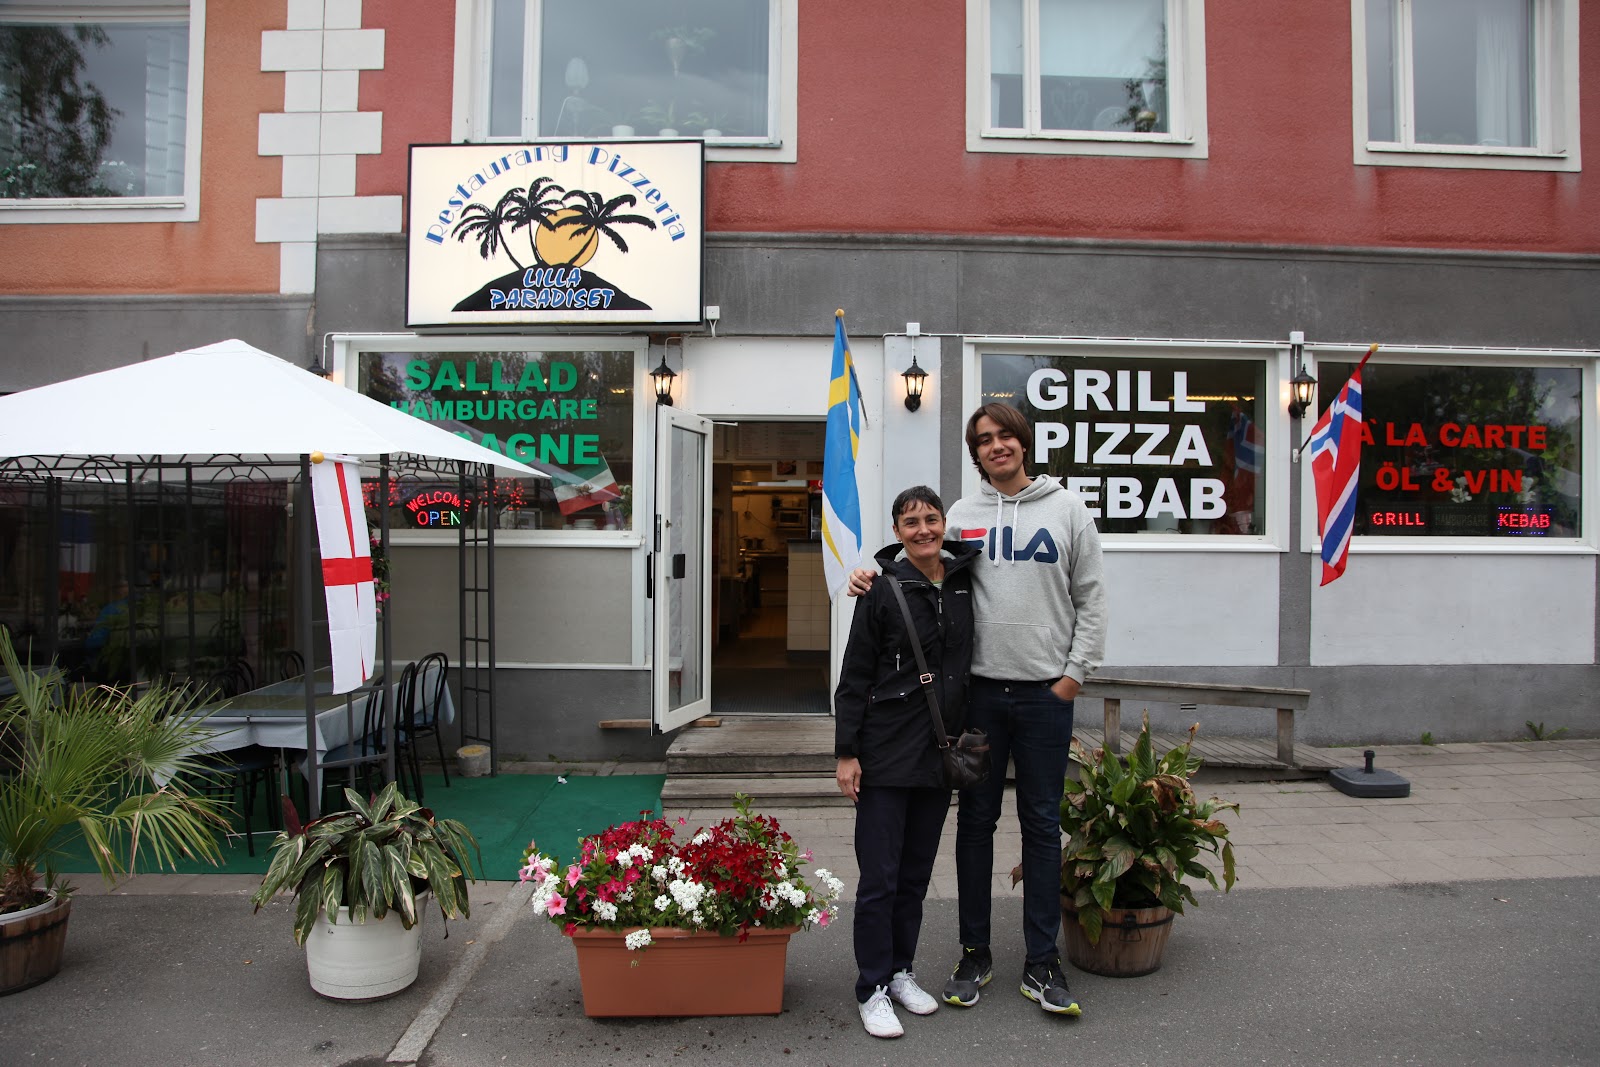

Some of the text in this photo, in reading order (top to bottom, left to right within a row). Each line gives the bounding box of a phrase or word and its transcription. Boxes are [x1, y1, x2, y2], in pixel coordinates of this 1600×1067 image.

[425, 145, 686, 246] Restaurang Pizzeria
[523, 268, 581, 288] LILLA
[490, 288, 615, 310] PARADISET
[405, 360, 578, 392] SALLAD
[1026, 368, 1206, 413] GRILL
[1034, 422, 1213, 466] PIZZA
[1386, 421, 1427, 447] LA
[1439, 422, 1547, 449] CARTE
[1376, 461, 1523, 494] ÖL & VIN
[1028, 476, 1227, 520] EBAB
[416, 510, 461, 526] OPEN
[1372, 512, 1425, 526] GRILL
[1498, 513, 1550, 528] KEBAB
